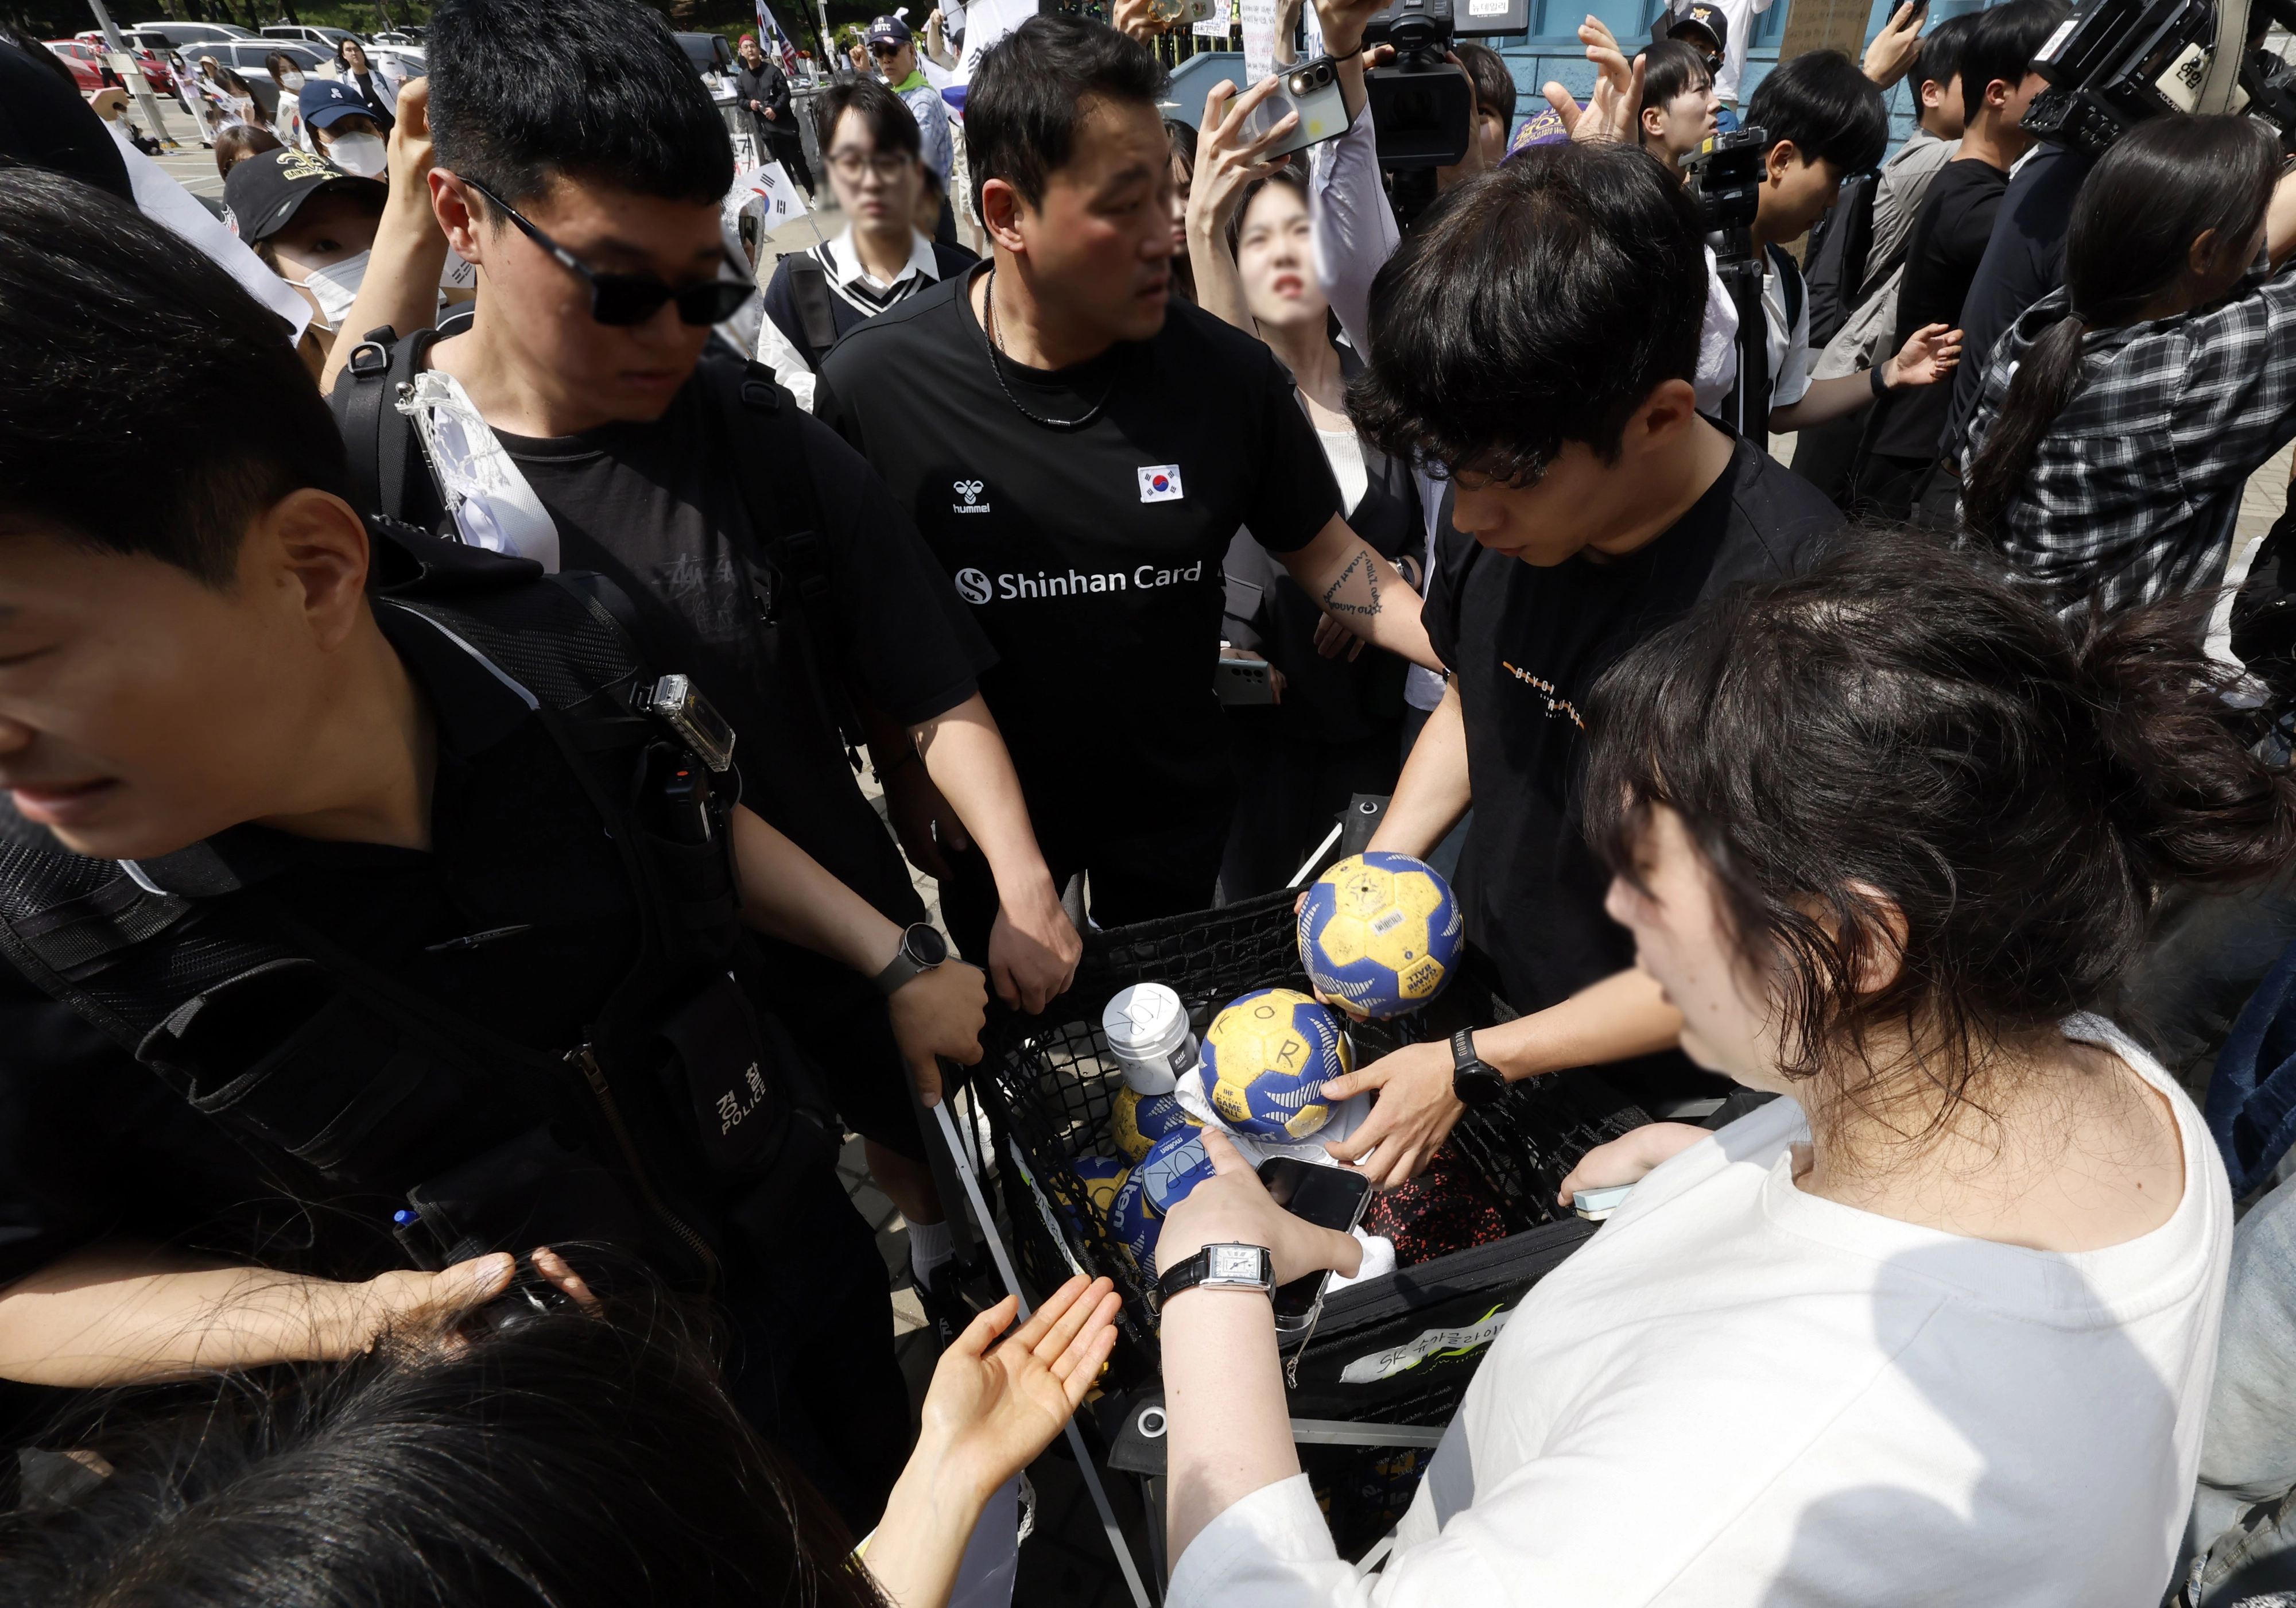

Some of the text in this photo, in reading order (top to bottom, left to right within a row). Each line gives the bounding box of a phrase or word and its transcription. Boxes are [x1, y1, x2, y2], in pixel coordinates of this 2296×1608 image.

[1473, 1, 1506, 12] 뉴데일리
[874, 24, 891, 33] ROTC
[2259, 111, 2283, 127] SONY
[953, 503, 990, 514] hummel
[998, 560, 1201, 600] Shinhan Card
[1407, 964, 1432, 981] BALL
[1104, 990, 1173, 1036] KOR
[1216, 1092, 1242, 1106] OFFICIAL
[1223, 1088, 1234, 1096] IHF
[722, 1080, 766, 1135] POLICE
[1216, 1097, 1243, 1113] GAME
[1219, 1105, 1241, 1119] BALL
[1160, 1137, 1183, 1154] molten
[1147, 1139, 1205, 1189] KOR
[1113, 1163, 1144, 1228] olten
[1377, 1323, 1505, 1373] SK 슈가글라이
